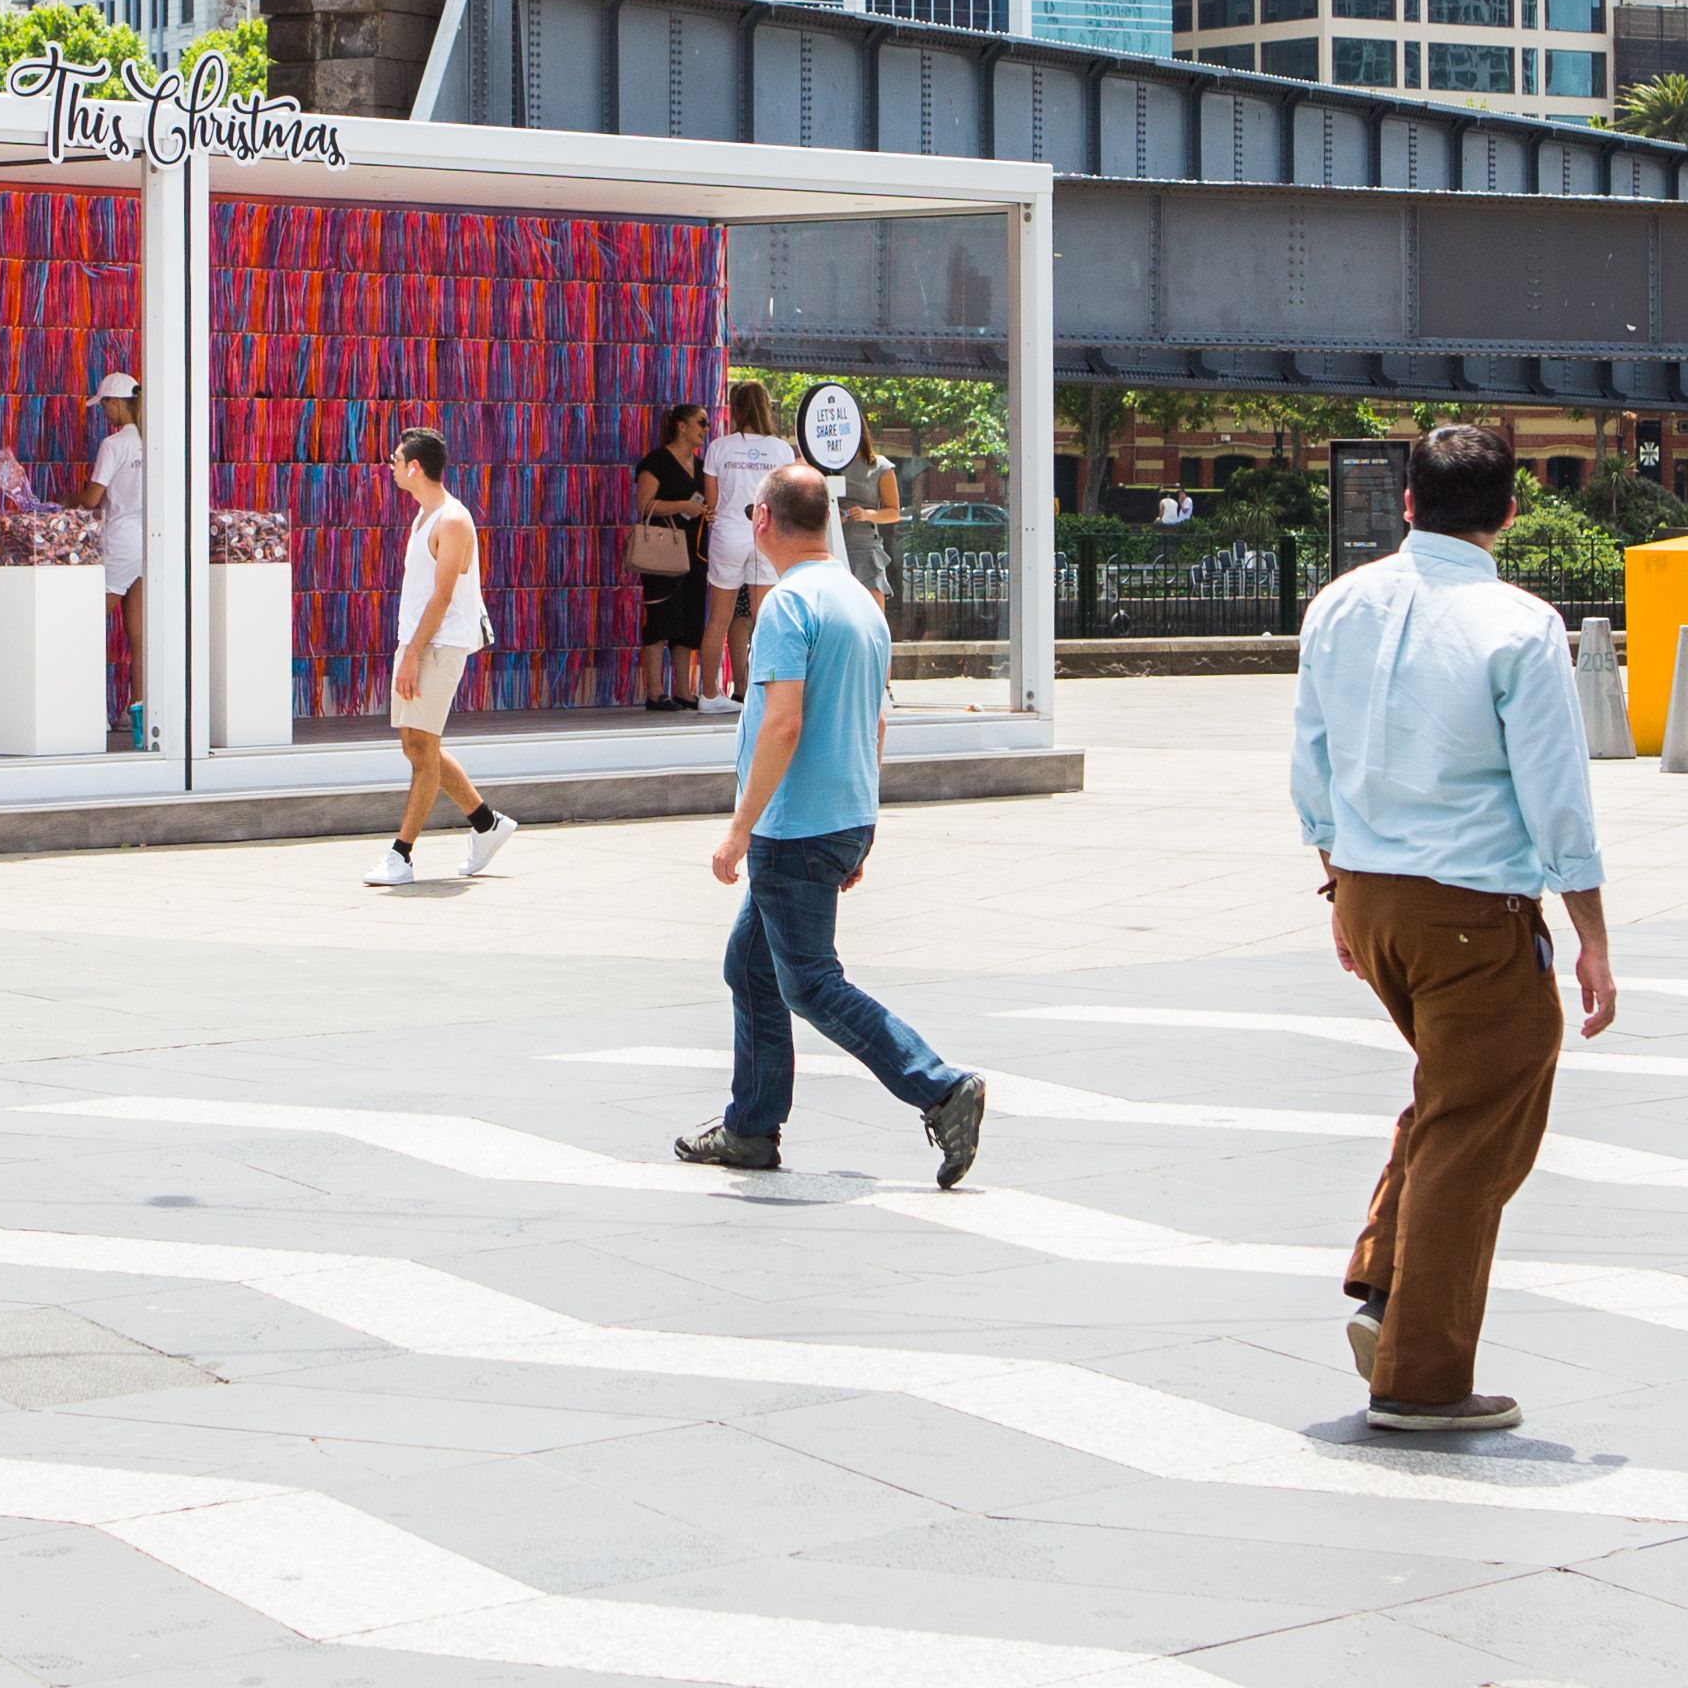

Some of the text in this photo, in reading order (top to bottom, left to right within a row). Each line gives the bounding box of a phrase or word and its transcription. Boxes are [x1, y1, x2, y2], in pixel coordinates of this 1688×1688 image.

[10, 45, 347, 167] This Christmas
[816, 407, 848, 422] LET'S ALL
[816, 424, 838, 438] SHARE
[827, 439, 842, 452] PART
[1581, 652, 1616, 672] 205
